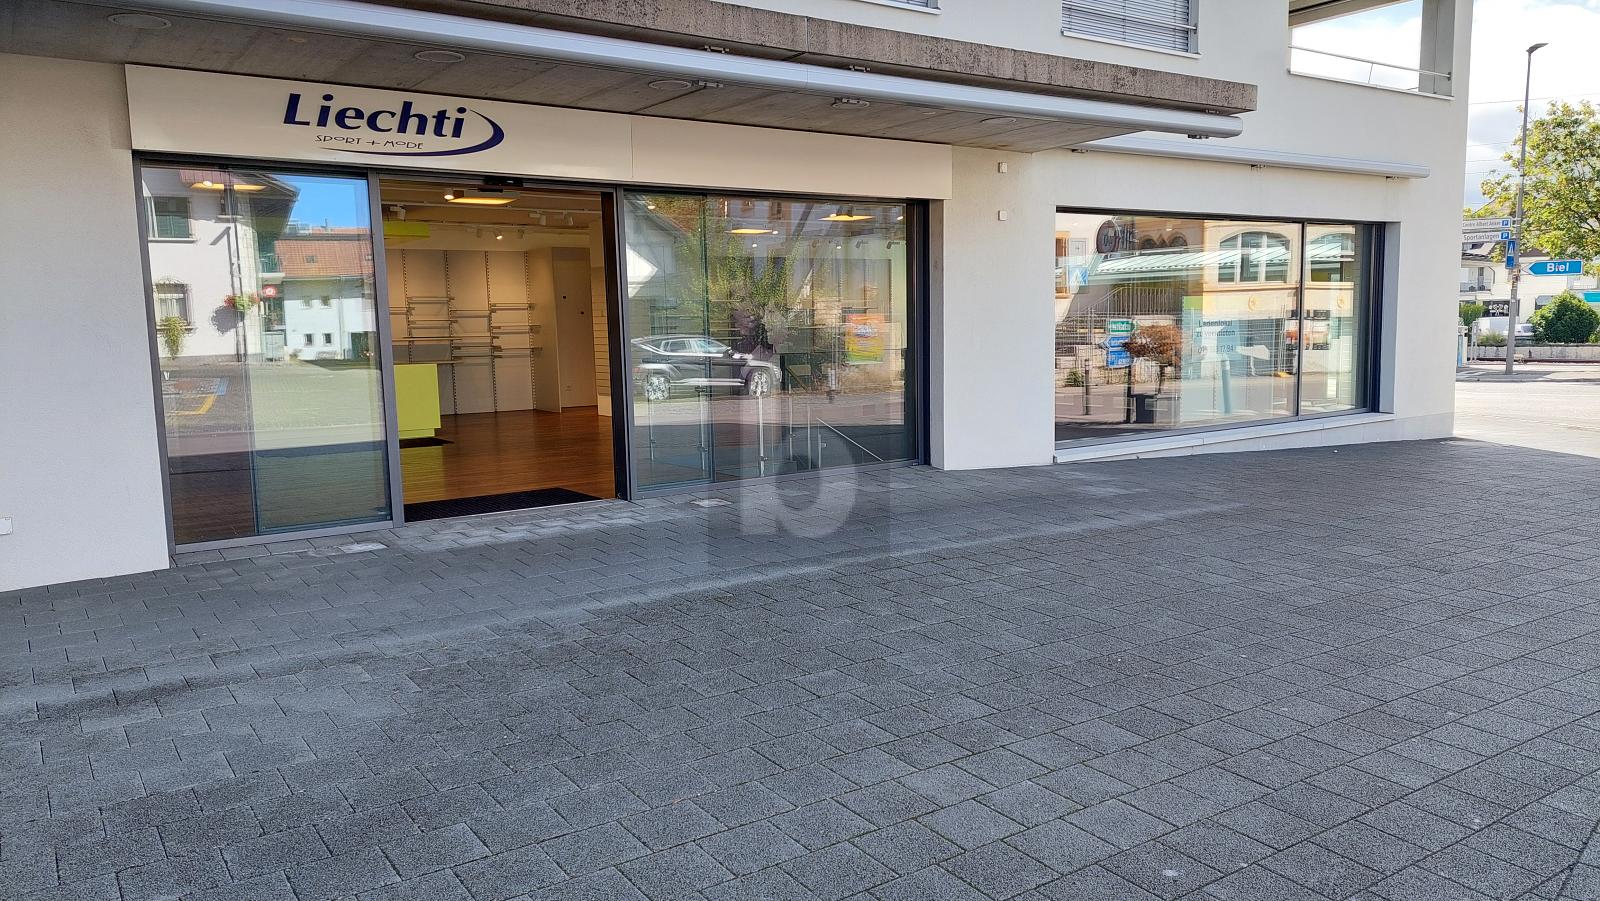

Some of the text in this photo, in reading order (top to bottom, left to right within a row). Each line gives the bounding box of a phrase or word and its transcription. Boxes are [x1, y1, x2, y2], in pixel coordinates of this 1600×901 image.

[283, 92, 467, 139] Liechti
[314, 135, 362, 145] SPORT
[383, 140, 424, 150] MODE
[1463, 233, 1500, 241] Sportanlagen
[1546, 262, 1569, 273] Biel
